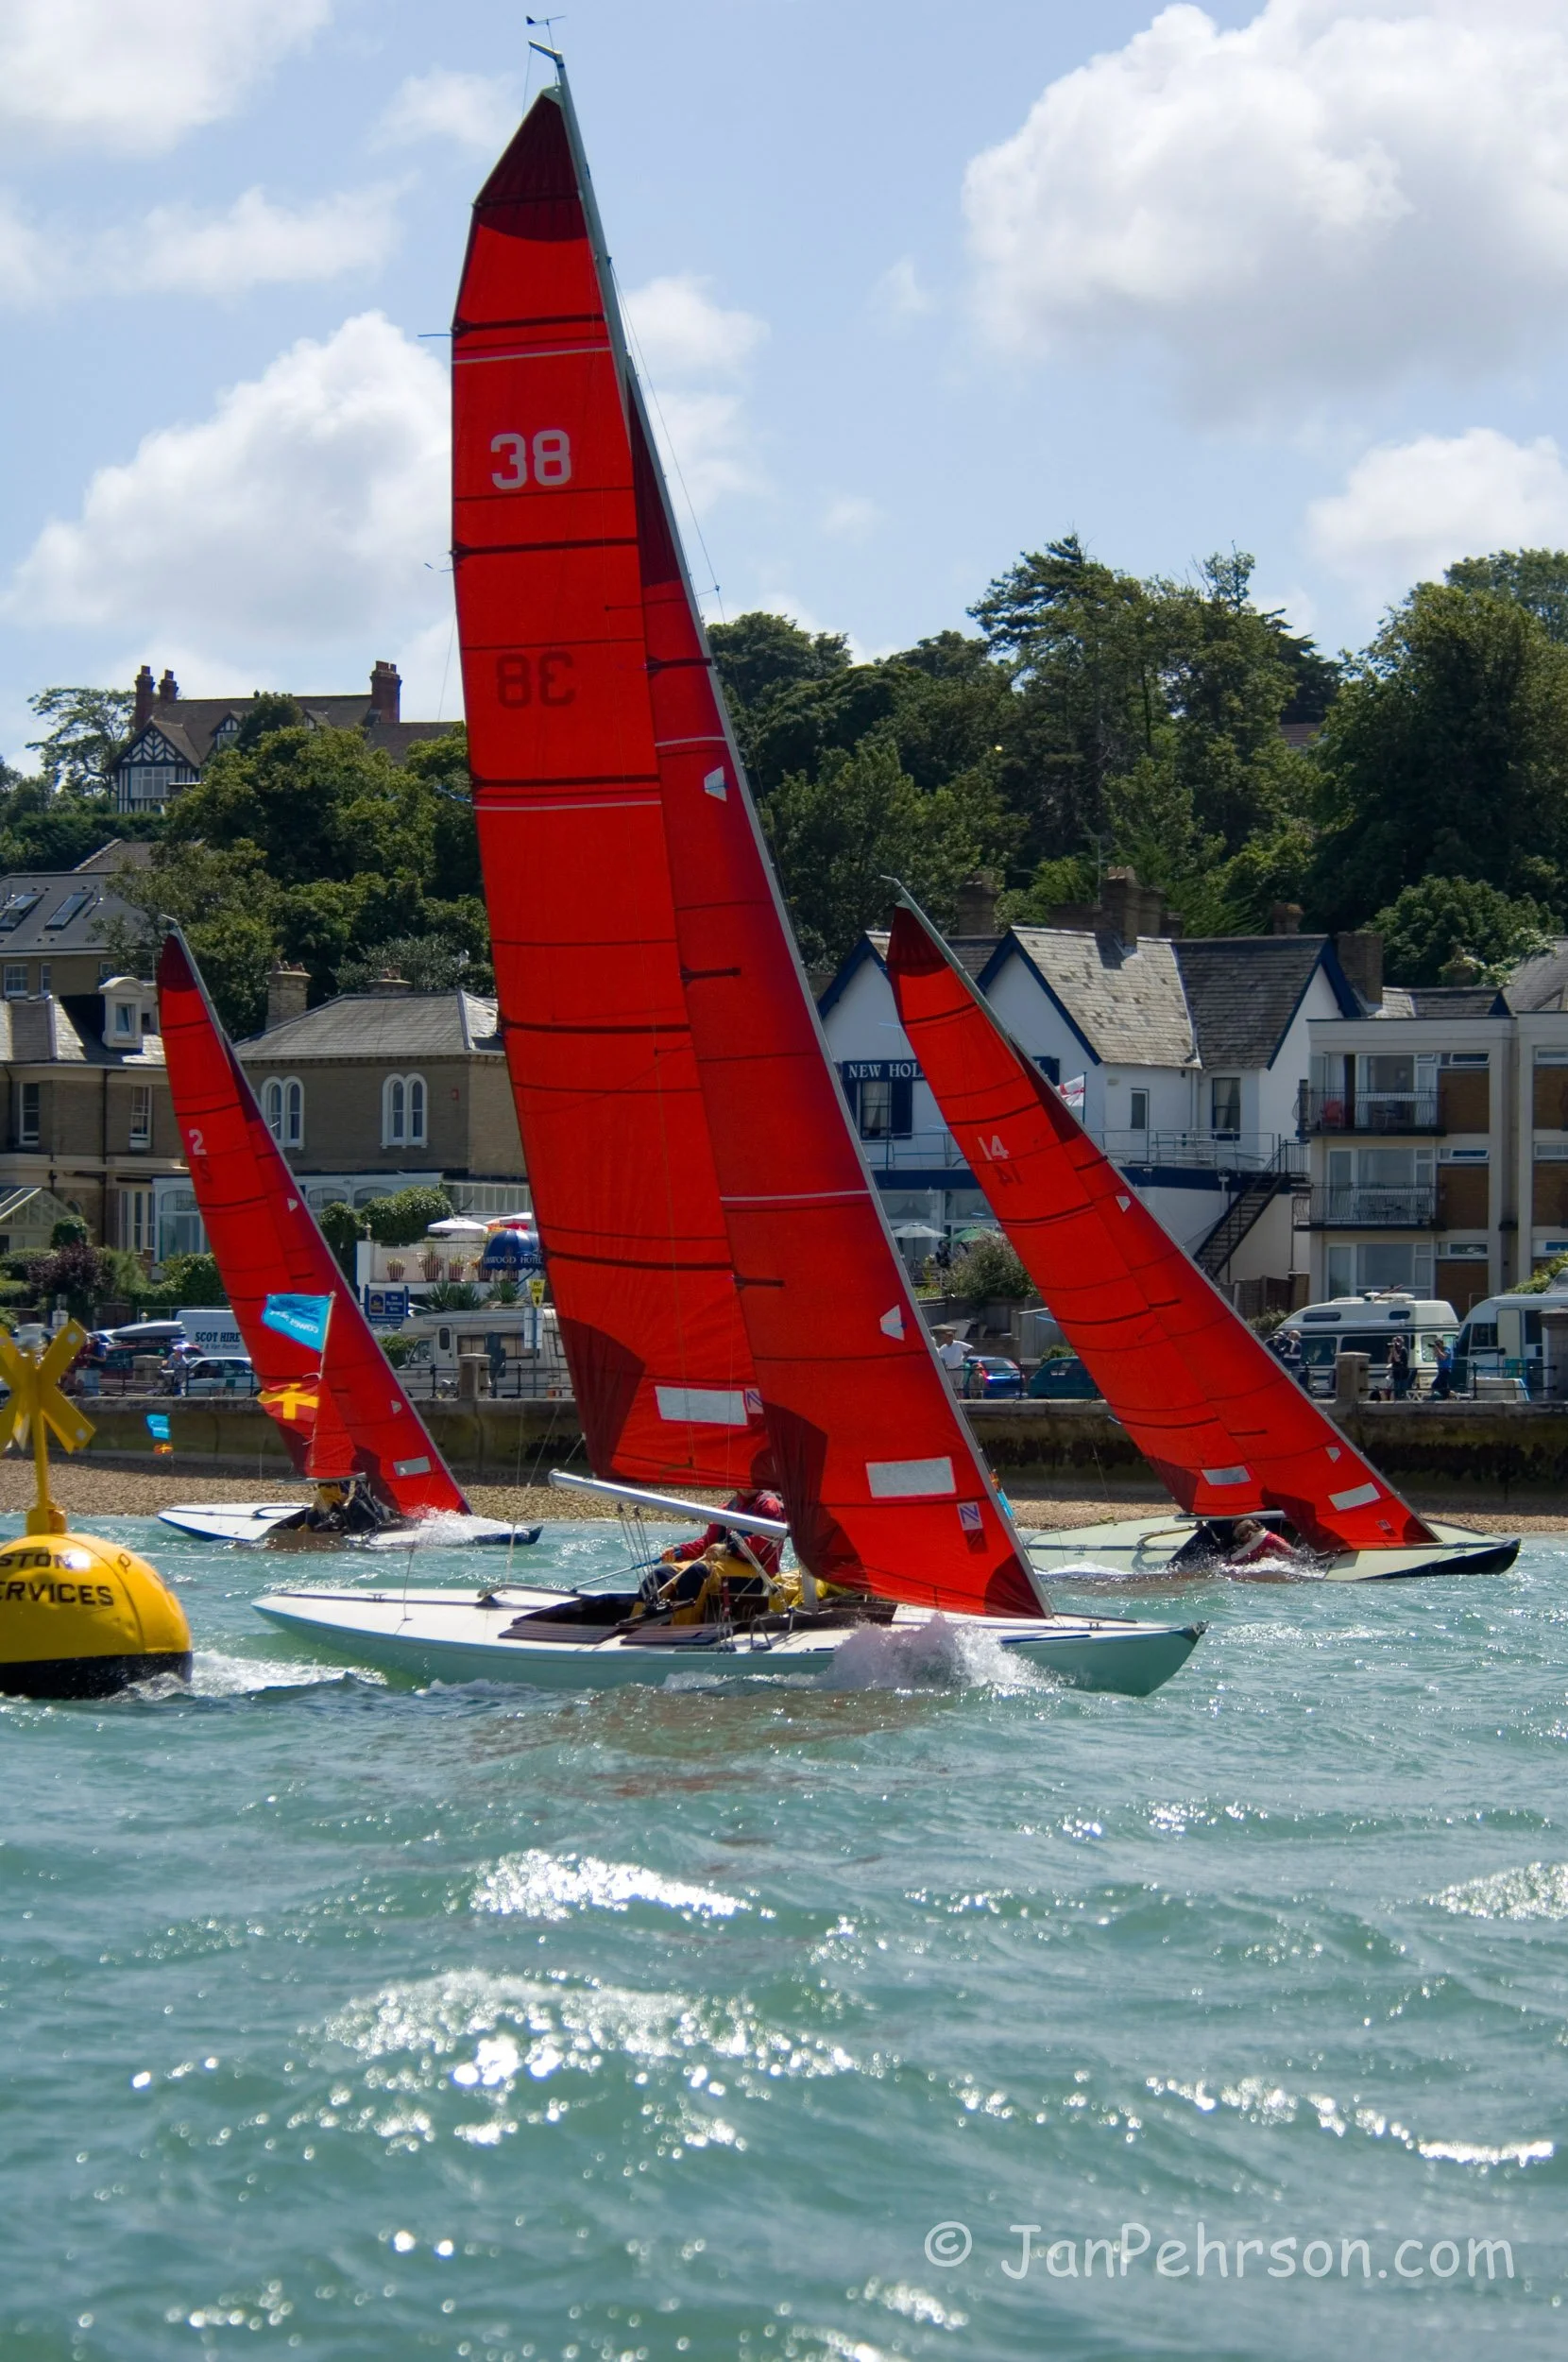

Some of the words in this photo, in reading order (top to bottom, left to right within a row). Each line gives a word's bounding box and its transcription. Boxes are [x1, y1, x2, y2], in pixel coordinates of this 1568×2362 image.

[490, 429, 571, 489] 38
[848, 1064, 881, 1078] NEW
[889, 1063, 925, 1078] HOL
[188, 1129, 207, 1155] 2
[978, 1135, 1010, 1161] 14
[195, 1331, 218, 1343] SCOT
[220, 1331, 241, 1343] HIRE
